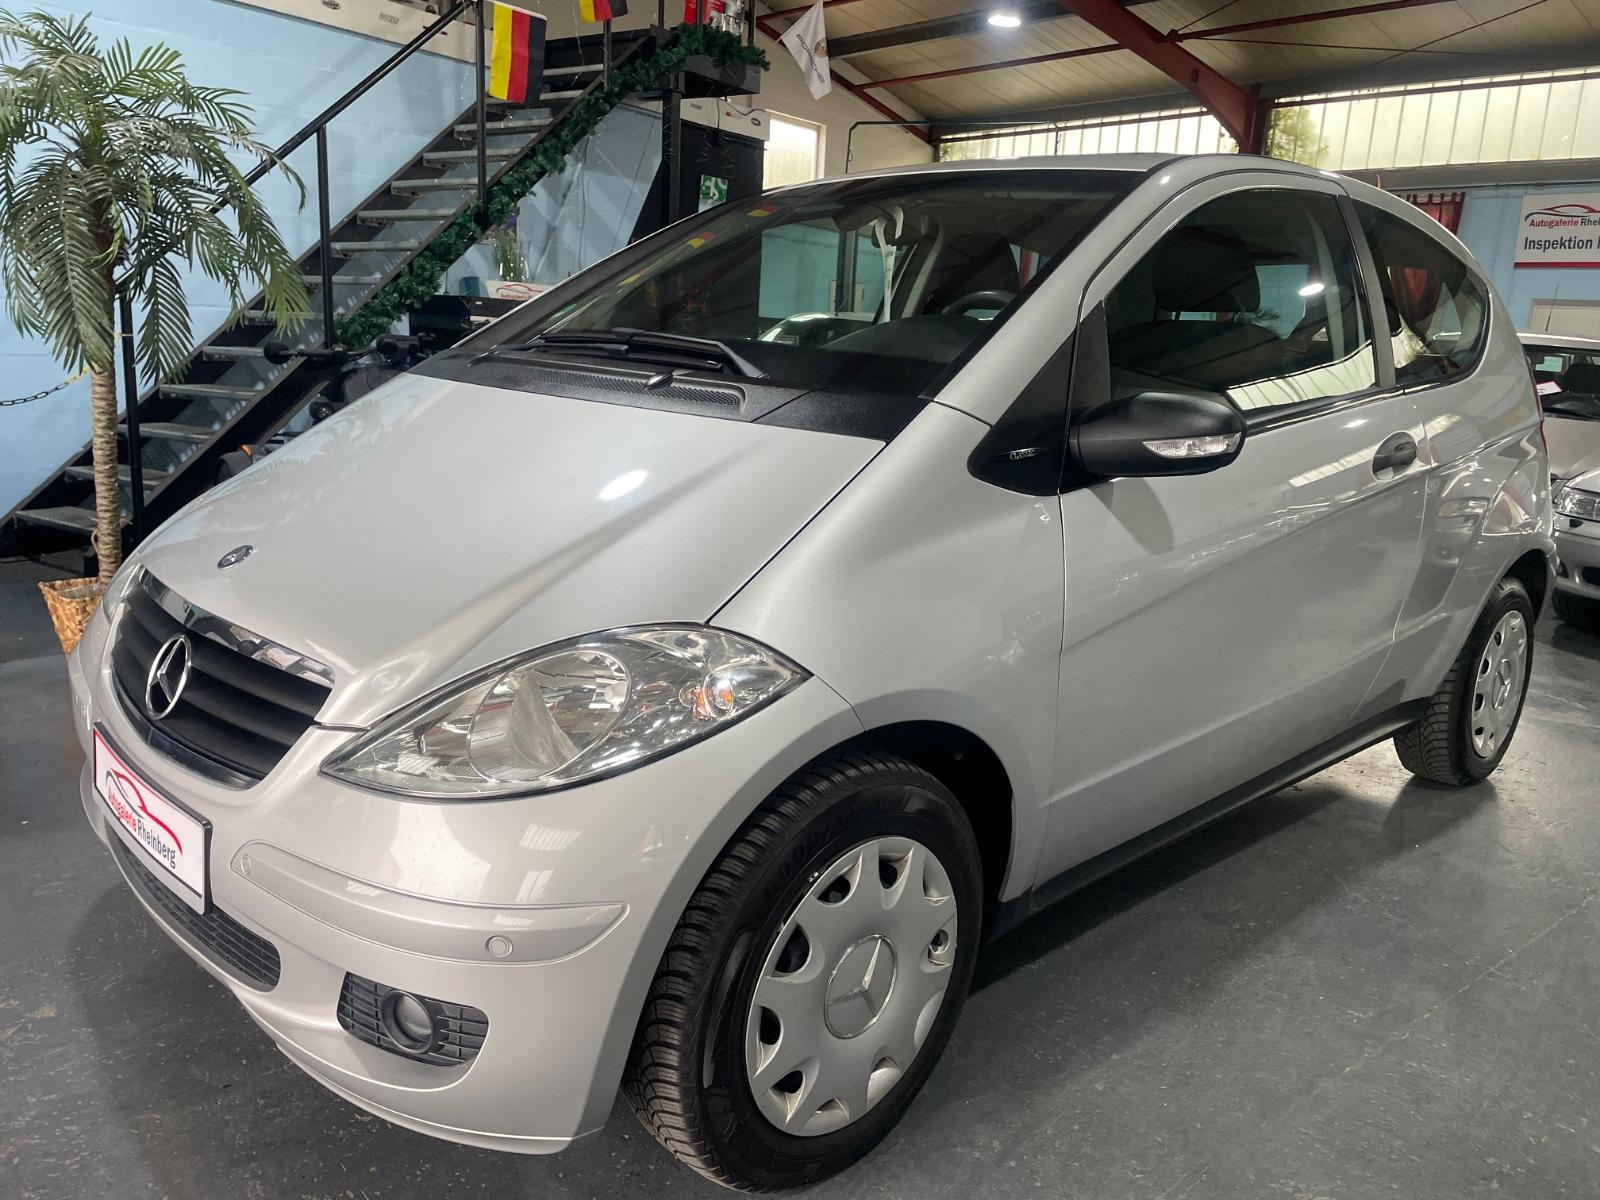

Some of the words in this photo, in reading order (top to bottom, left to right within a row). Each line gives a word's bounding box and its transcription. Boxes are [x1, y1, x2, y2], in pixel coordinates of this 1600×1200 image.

[1529, 218, 1579, 228] Autogalerie
[1524, 236, 1593, 252] Inspektion
[108, 786, 137, 833] Autogalerie
[135, 817, 176, 869] Rheinberg
